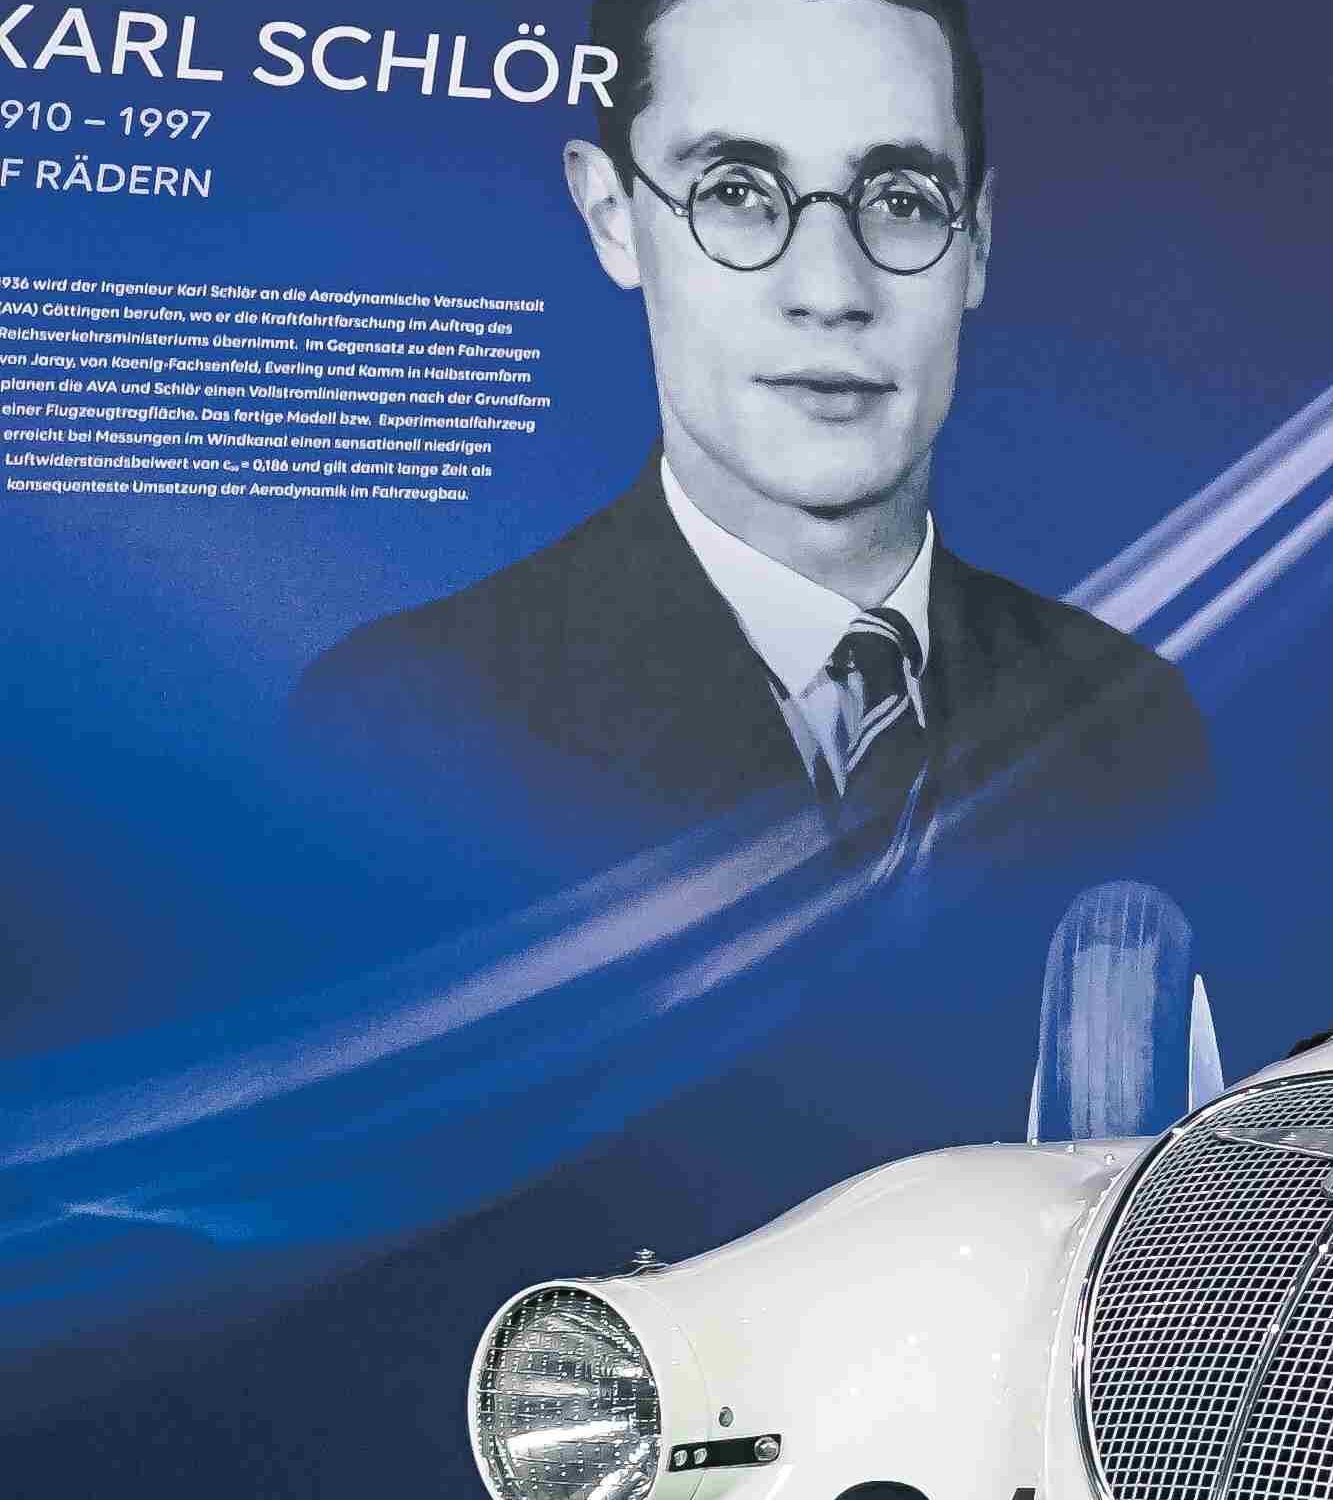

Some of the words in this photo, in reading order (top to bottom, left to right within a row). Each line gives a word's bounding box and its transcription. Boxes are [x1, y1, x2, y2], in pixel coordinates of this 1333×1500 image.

[252, 22, 620, 108] SCHLÖR
[119, 106, 213, 140] 1997
[35, 154, 212, 199] RÄDERN
[0, 277, 30, 290] 936
